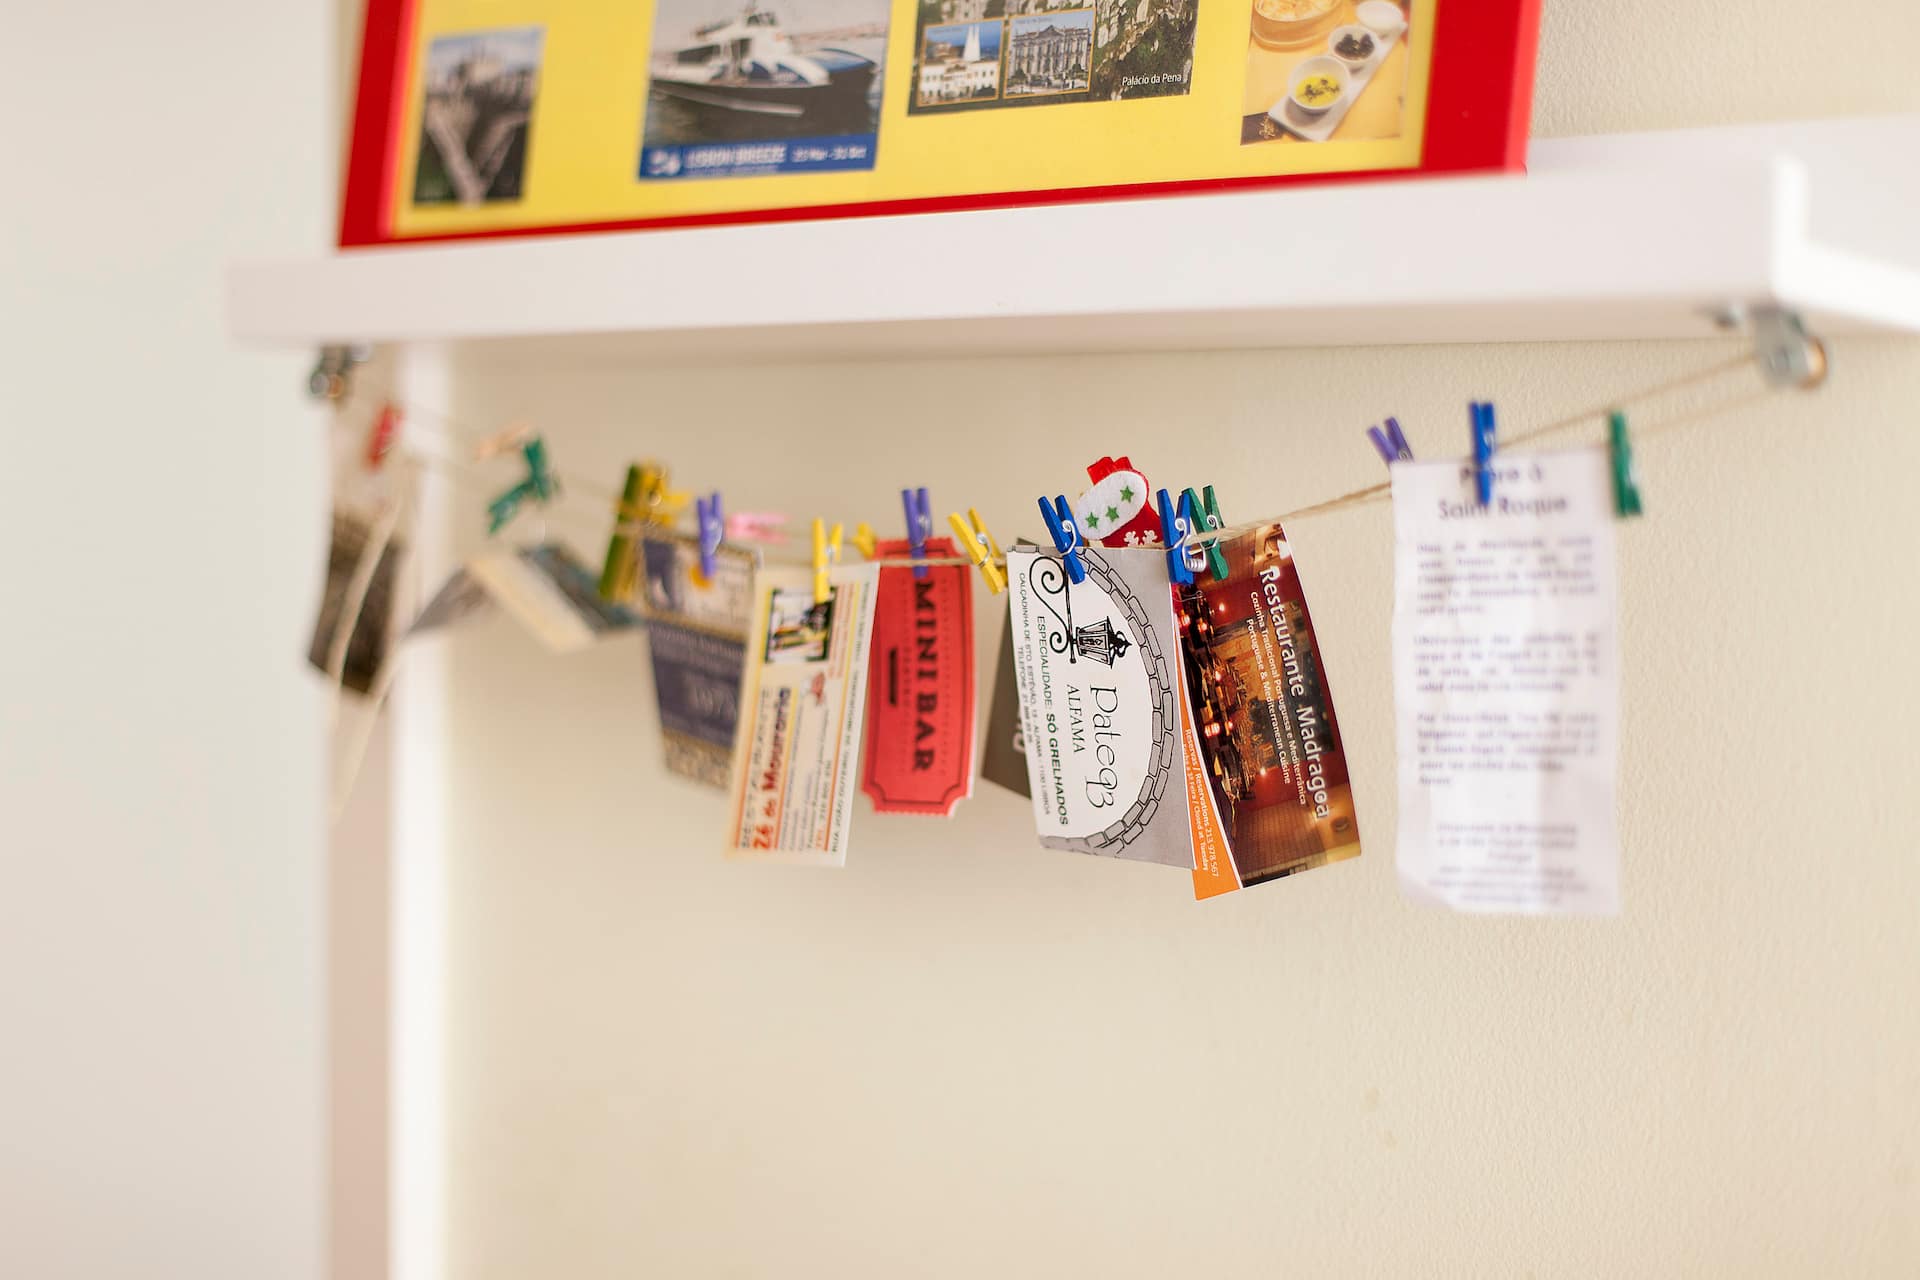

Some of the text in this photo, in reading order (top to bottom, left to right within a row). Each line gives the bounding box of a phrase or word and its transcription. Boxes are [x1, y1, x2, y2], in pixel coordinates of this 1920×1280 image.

[1122, 73, 1182, 86] Palácio da Pena
[1498, 496, 1567, 517] Roque
[1017, 572, 1031, 626] CALÇADINHA
[1023, 630, 1030, 640] DE
[913, 580, 937, 769] MINI BAR
[1246, 618, 1292, 784] Portuguese & Mediterranean Cuisine
[1249, 590, 1266, 628] Cozinha
[1261, 628, 1279, 678] Tradicional
[1274, 678, 1292, 731] Portuguesa
[1287, 739, 1308, 805] Mediterrânica
[1259, 565, 1330, 819] Restaurante Madragoa
[1046, 713, 1058, 733] SÓ
[1067, 684, 1084, 752] ALFAMA
[1049, 738, 1067, 824] GRELHADOS
[1184, 728, 1198, 765] Reservas
[1195, 773, 1210, 826] Reservations
[1192, 805, 1204, 830] Closed
[1198, 842, 1210, 870] Tuesday
